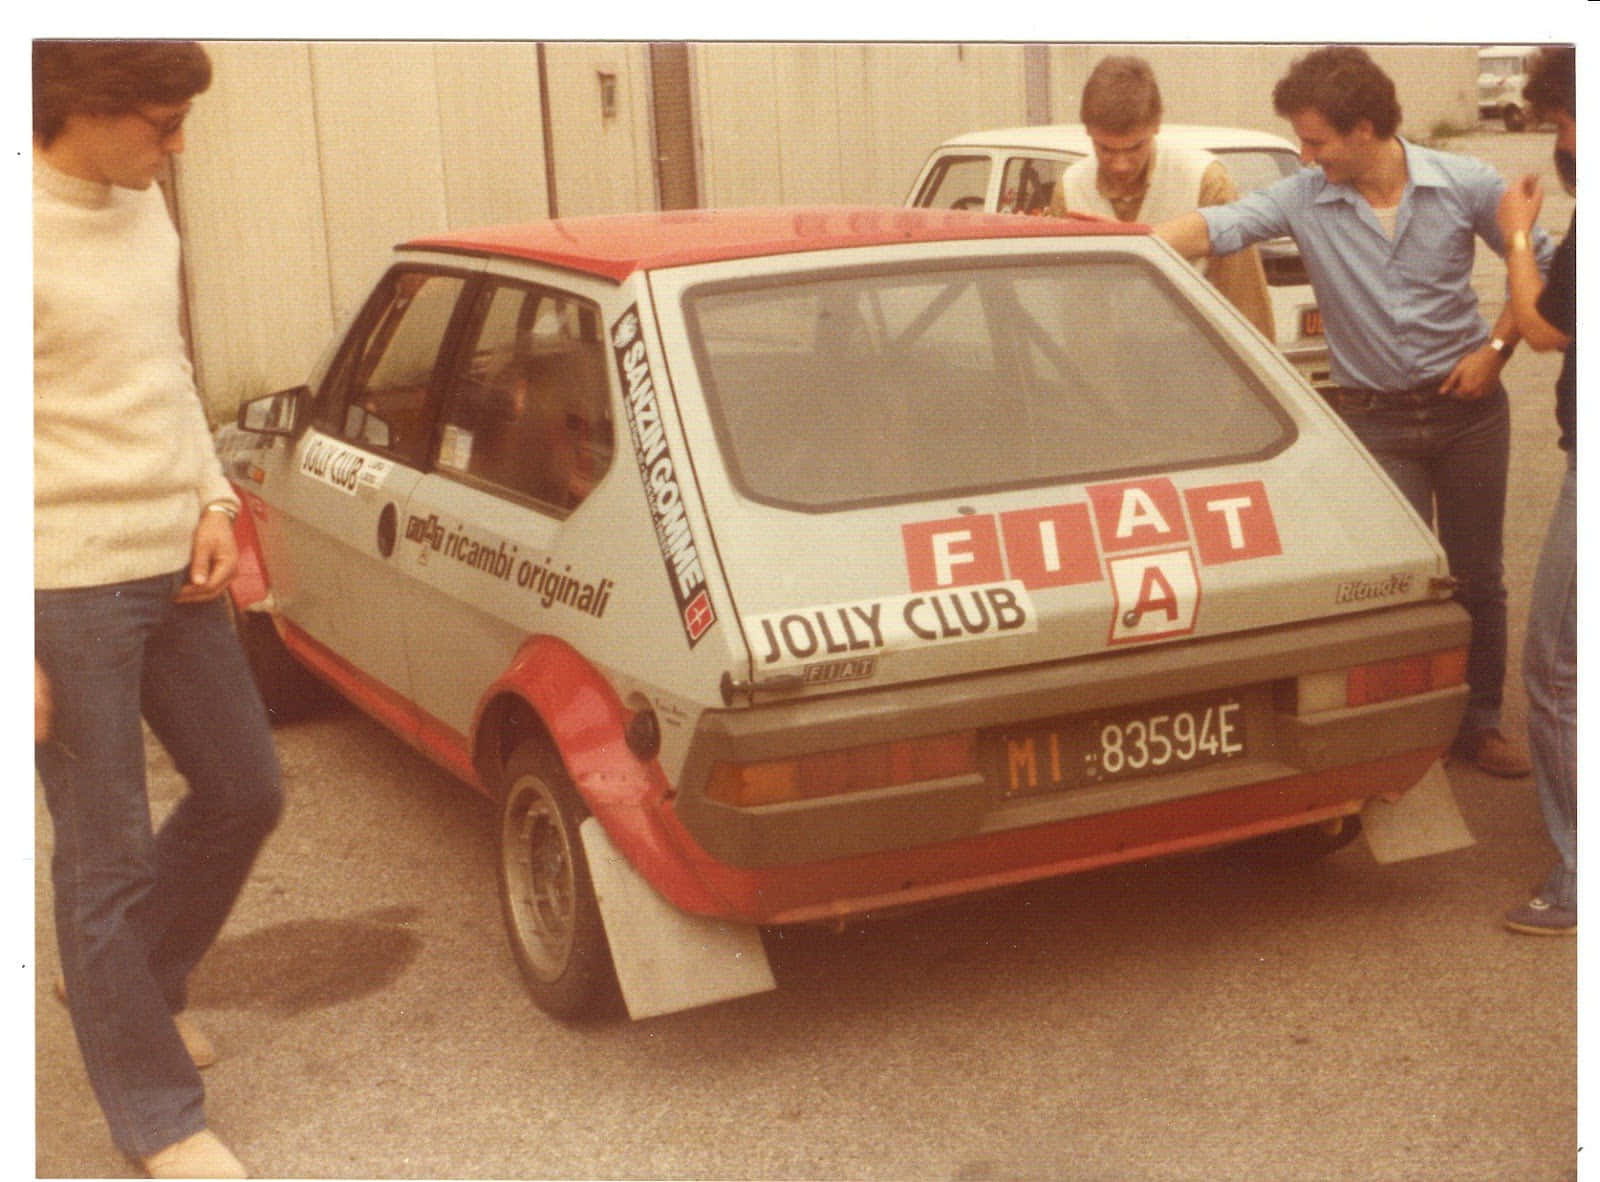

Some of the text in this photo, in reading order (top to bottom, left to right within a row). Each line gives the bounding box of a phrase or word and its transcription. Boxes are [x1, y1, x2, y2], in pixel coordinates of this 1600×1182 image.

[622, 340, 667, 466] SANZIN
[650, 457, 705, 600] GOMME
[443, 524, 517, 582] ricambi
[516, 556, 614, 619] originali
[930, 487, 1252, 586] FIAT
[760, 587, 1027, 663] JOLLY CLUB
[807, 660, 874, 681] FIAT
[1101, 703, 1243, 773] 83594E
